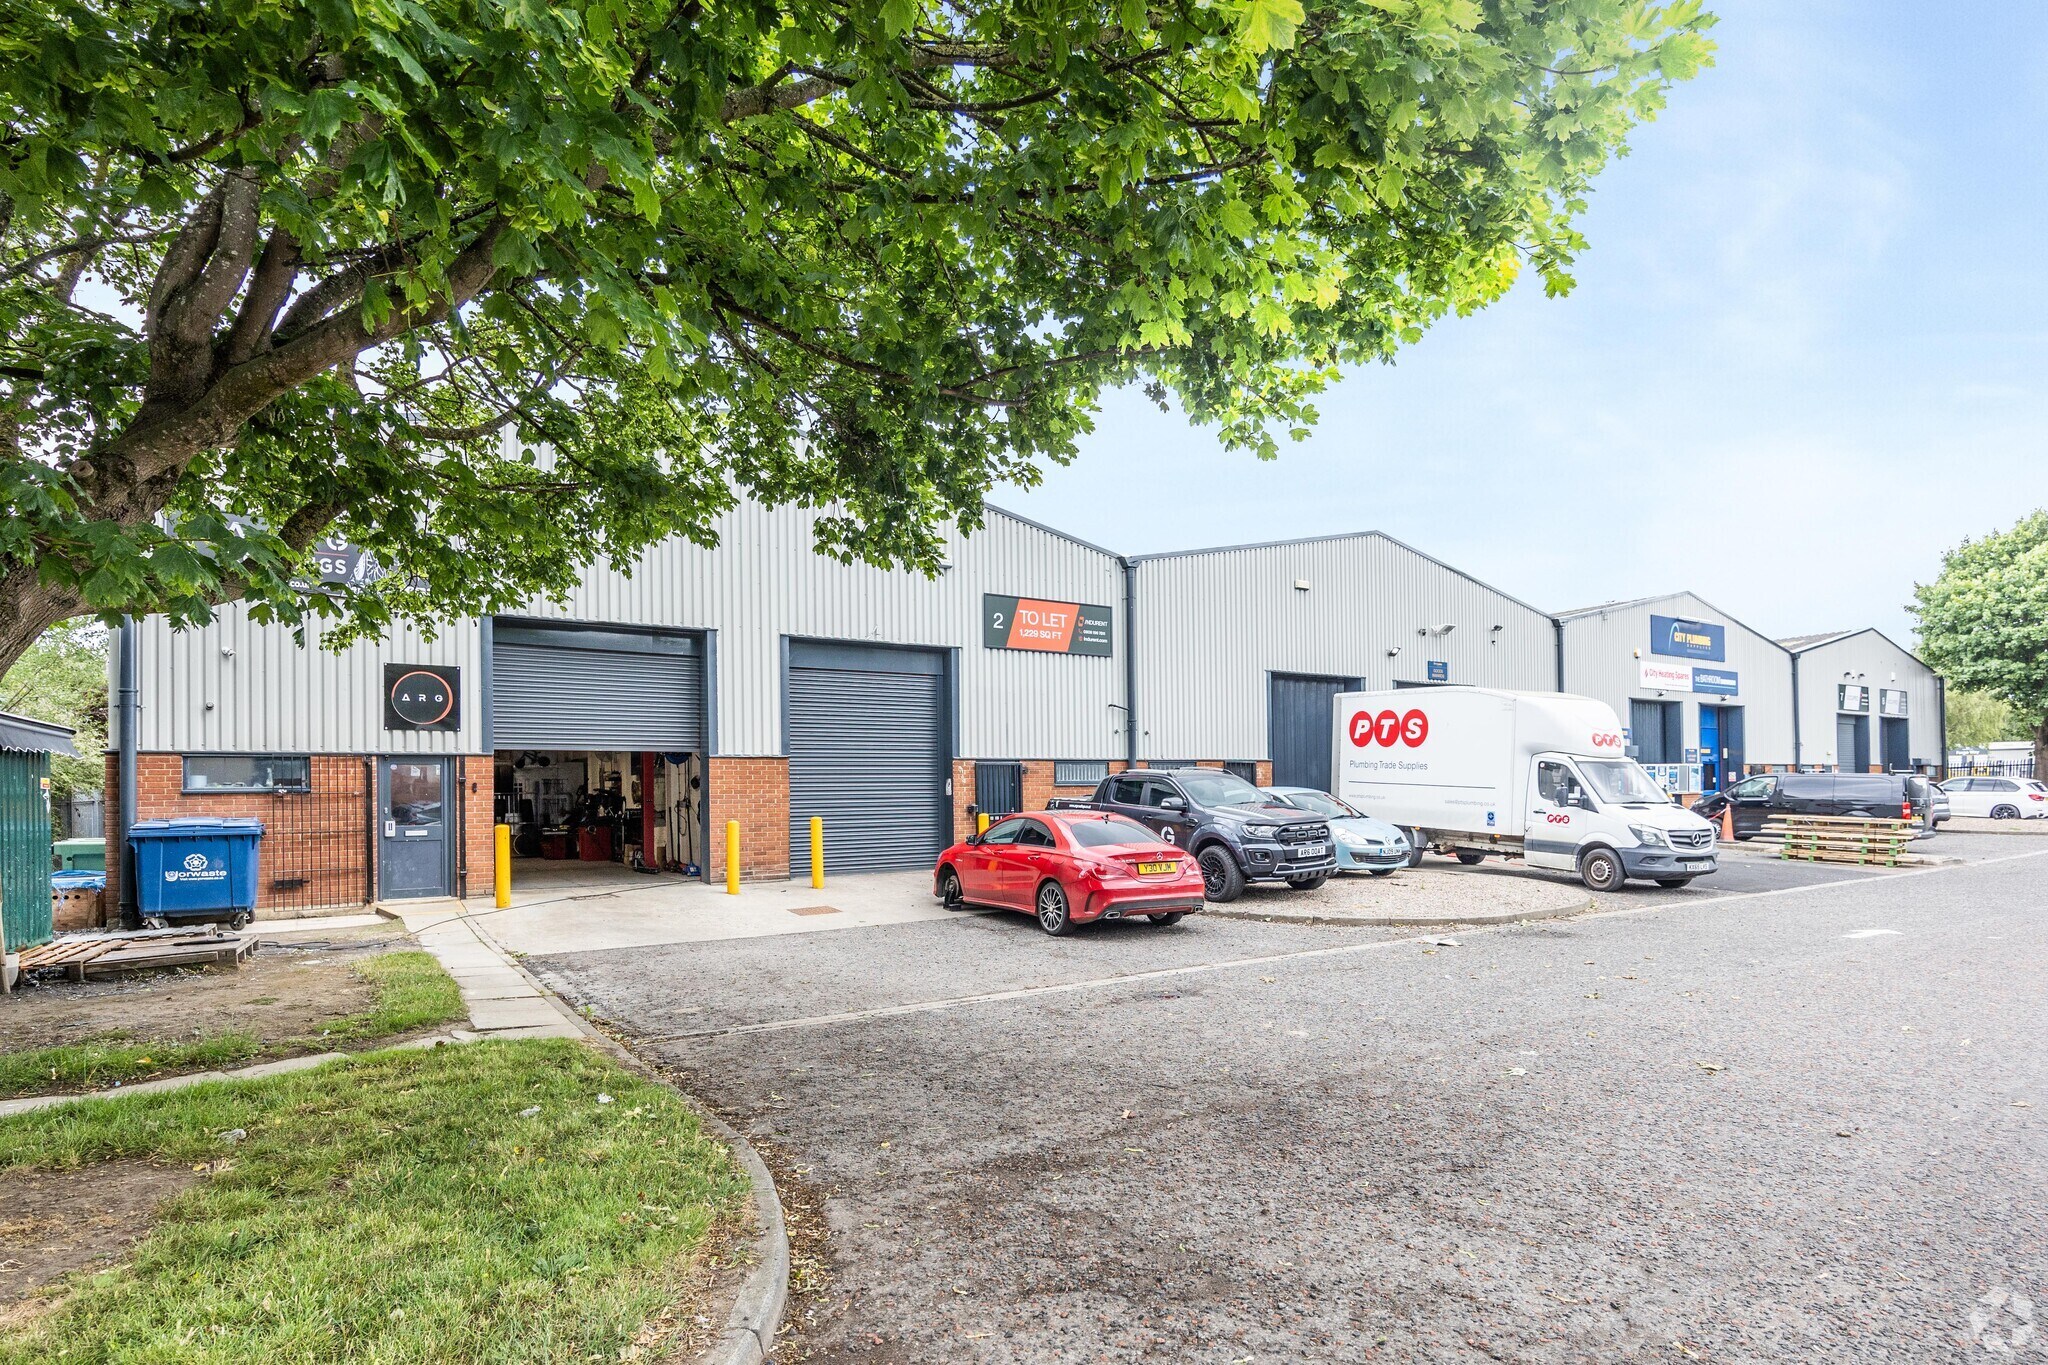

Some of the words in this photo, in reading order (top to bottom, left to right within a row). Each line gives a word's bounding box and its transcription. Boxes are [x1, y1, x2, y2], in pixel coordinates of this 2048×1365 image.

[993, 612, 1004, 629] 2
[1019, 610, 1039, 625] TO
[1042, 612, 1068, 628] LET
[1084, 619, 1108, 627] INDURENT
[1019, 629, 1039, 639] 1,229
[1040, 630, 1051, 640] SQ
[1052, 631, 1063, 640] FT
[1649, 668, 1658, 678] City
[1658, 670, 1674, 680] Heating
[1675, 671, 1689, 680] Spares
[1353, 717, 1423, 740] PTS
[1594, 734, 1621, 747] PTS
[1350, 760, 1378, 770] Plumbing
[1379, 760, 1397, 770] Trade
[1398, 761, 1428, 771] Supplies
[1286, 829, 1328, 839] FORD
[165, 870, 227, 882] yorwaste
